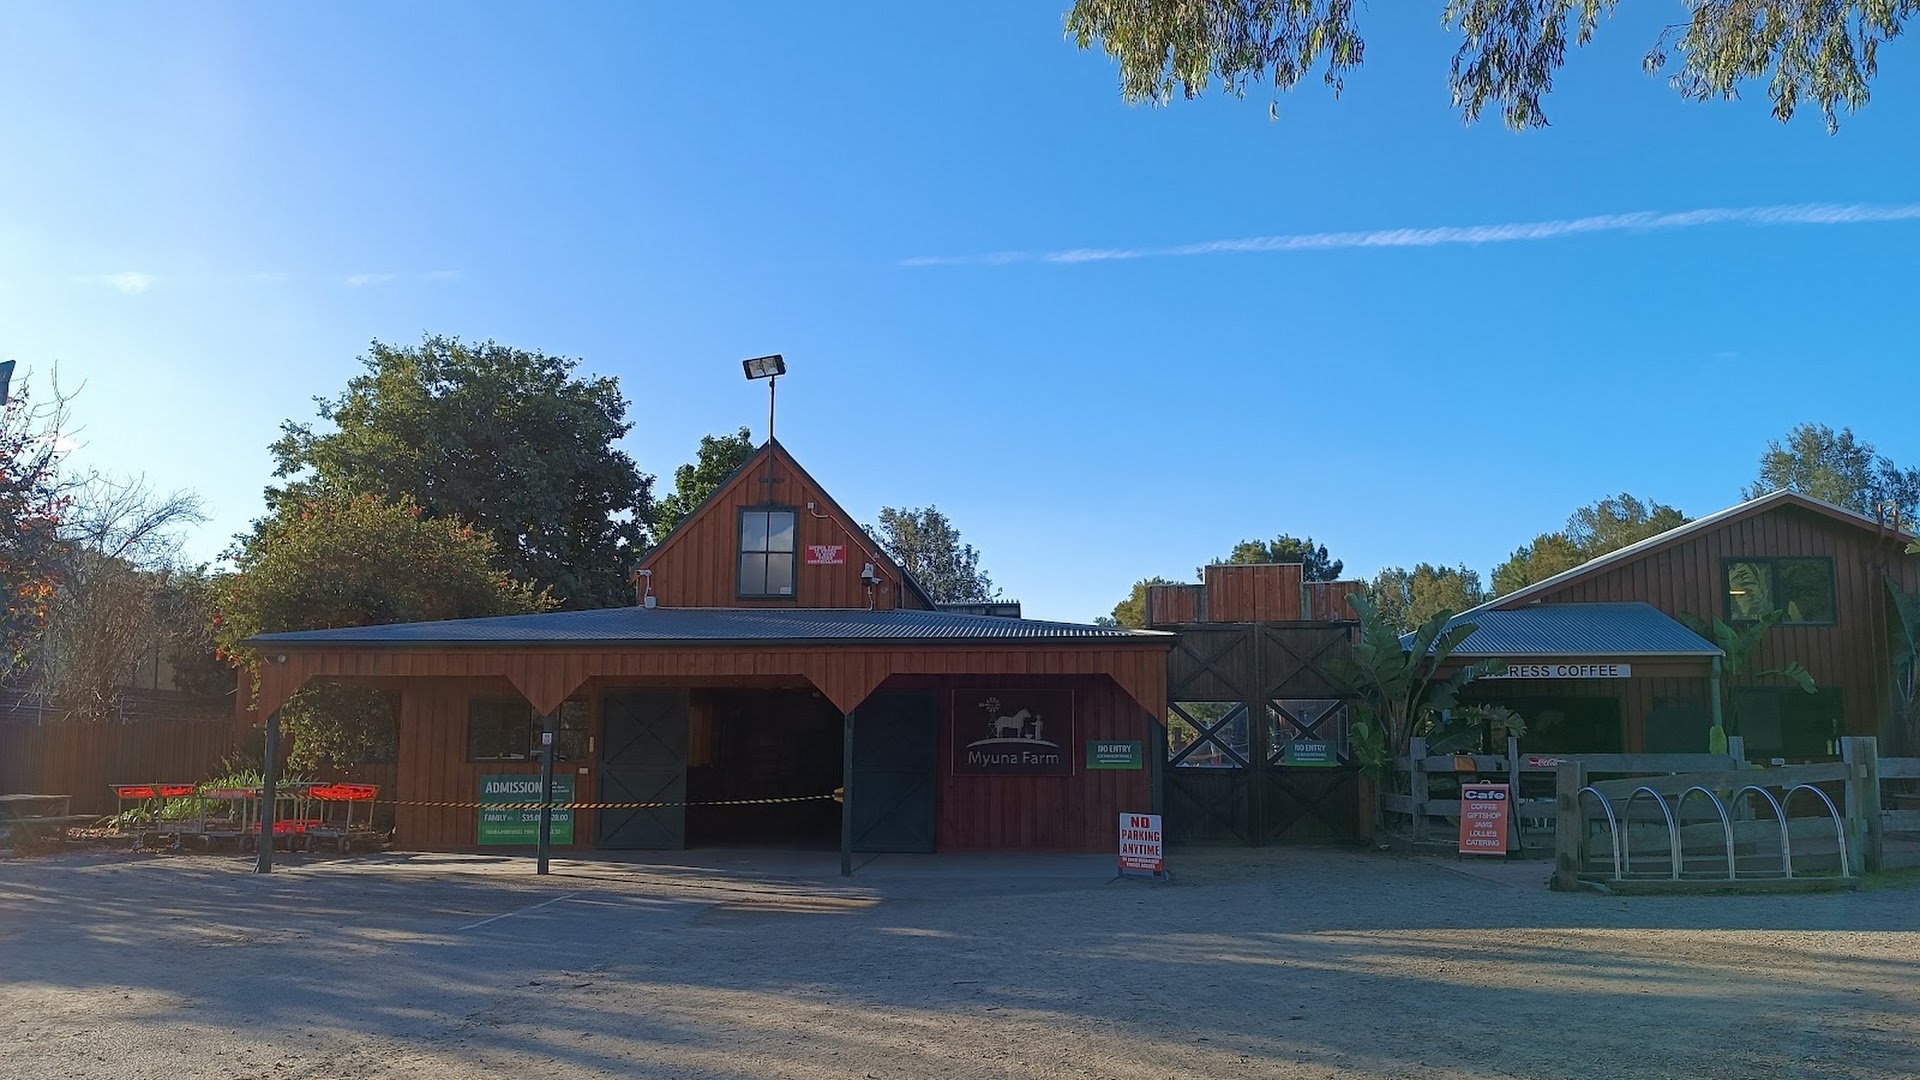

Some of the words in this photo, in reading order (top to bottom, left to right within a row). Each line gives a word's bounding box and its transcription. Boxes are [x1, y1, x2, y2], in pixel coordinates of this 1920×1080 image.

[1489, 665, 1550, 677] RESS
[1557, 665, 1619, 677] COFFEE
[1097, 744, 1109, 753] NO
[1109, 744, 1132, 753] ENTRY
[1294, 744, 1304, 752] NO
[1305, 744, 1327, 752] ENTRY
[968, 751, 1018, 767] Myuna
[1022, 751, 1060, 764] Farm
[1464, 790, 1506, 800] Cafe
[484, 814, 507, 822] FAMILY
[1131, 816, 1151, 829] NO
[1121, 829, 1161, 842] PARKING
[1469, 830, 1498, 838] LOLLIES
[1466, 839, 1500, 847] CATERING
[1122, 843, 1160, 856] ANYTIME
